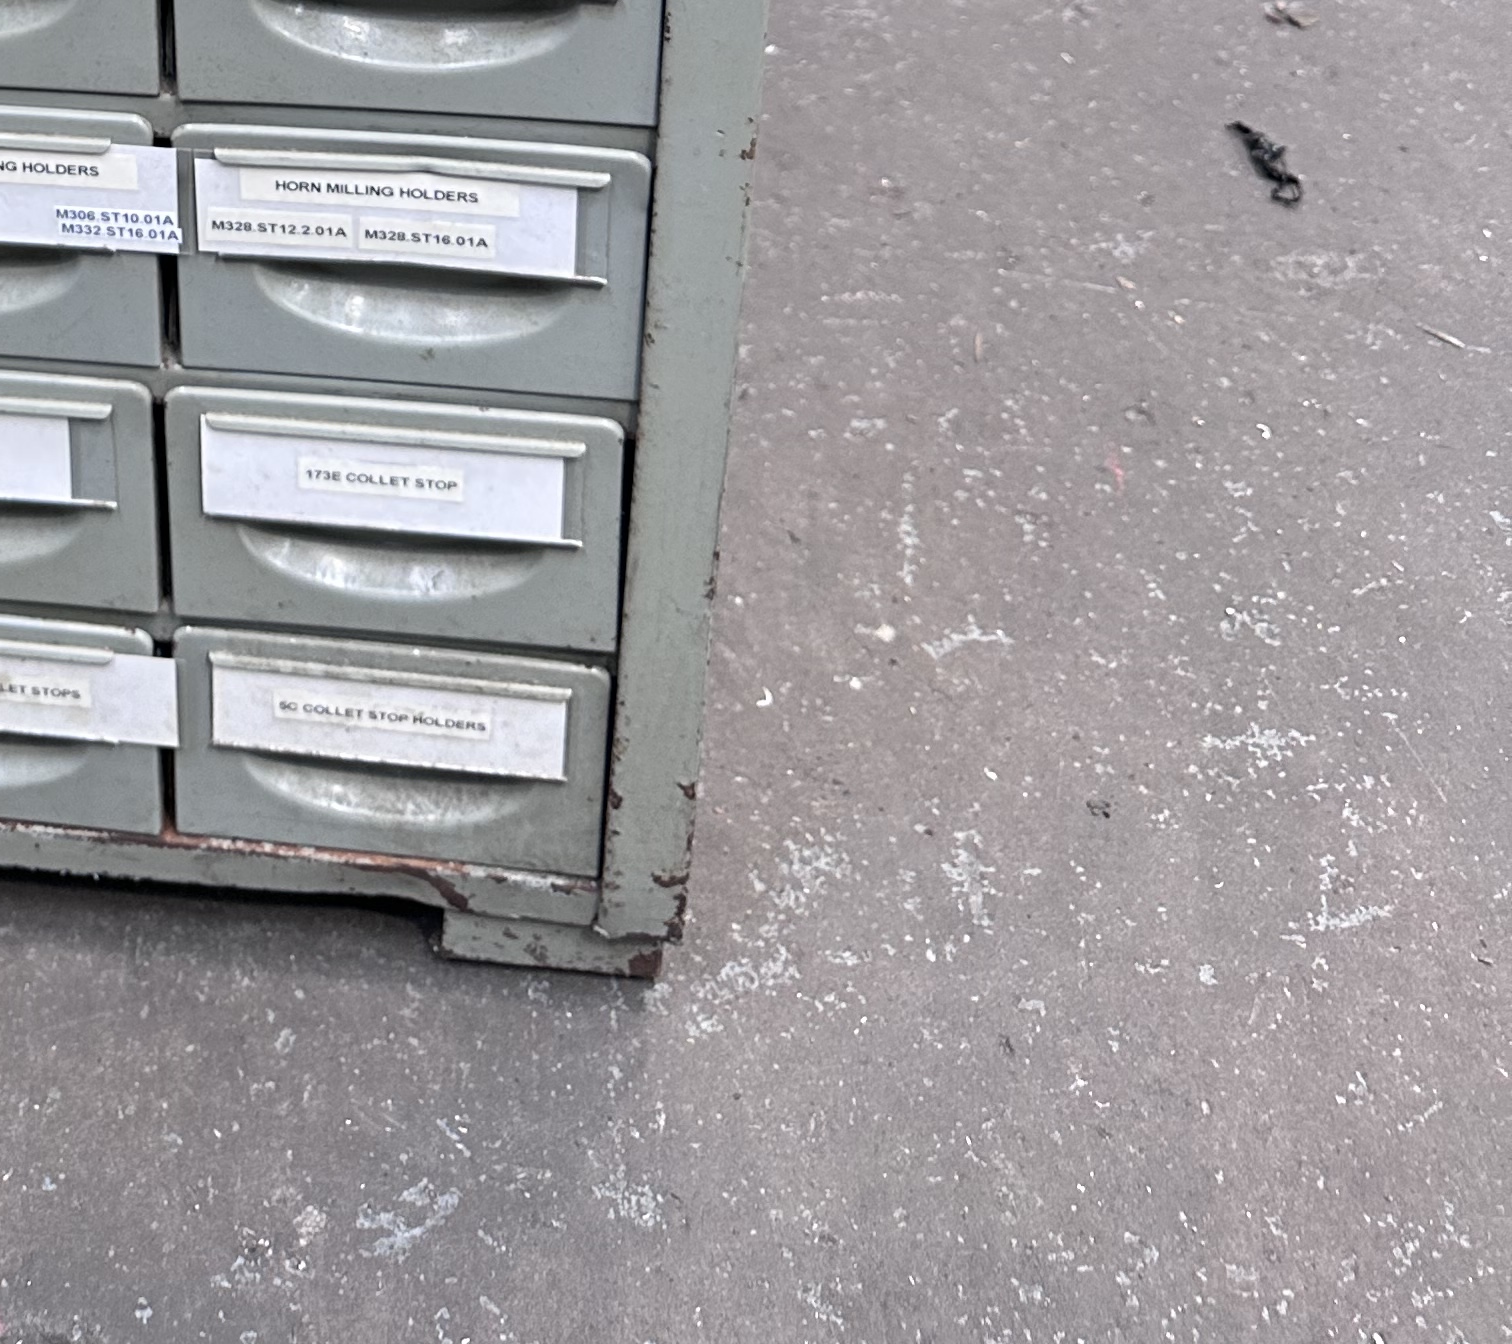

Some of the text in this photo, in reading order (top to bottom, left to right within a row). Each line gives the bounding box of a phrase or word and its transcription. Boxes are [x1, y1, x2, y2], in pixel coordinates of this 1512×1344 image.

[21, 162, 100, 178] HOLDERS
[275, 179, 480, 204] HORN MILLING HOLDERS
[305, 469, 458, 491] 173E COLLET STOP
[31, 685, 82, 700] STOPS
[302, 703, 365, 719] COLLET
[367, 710, 410, 723] STOP
[412, 715, 487, 732] HOLDERS
